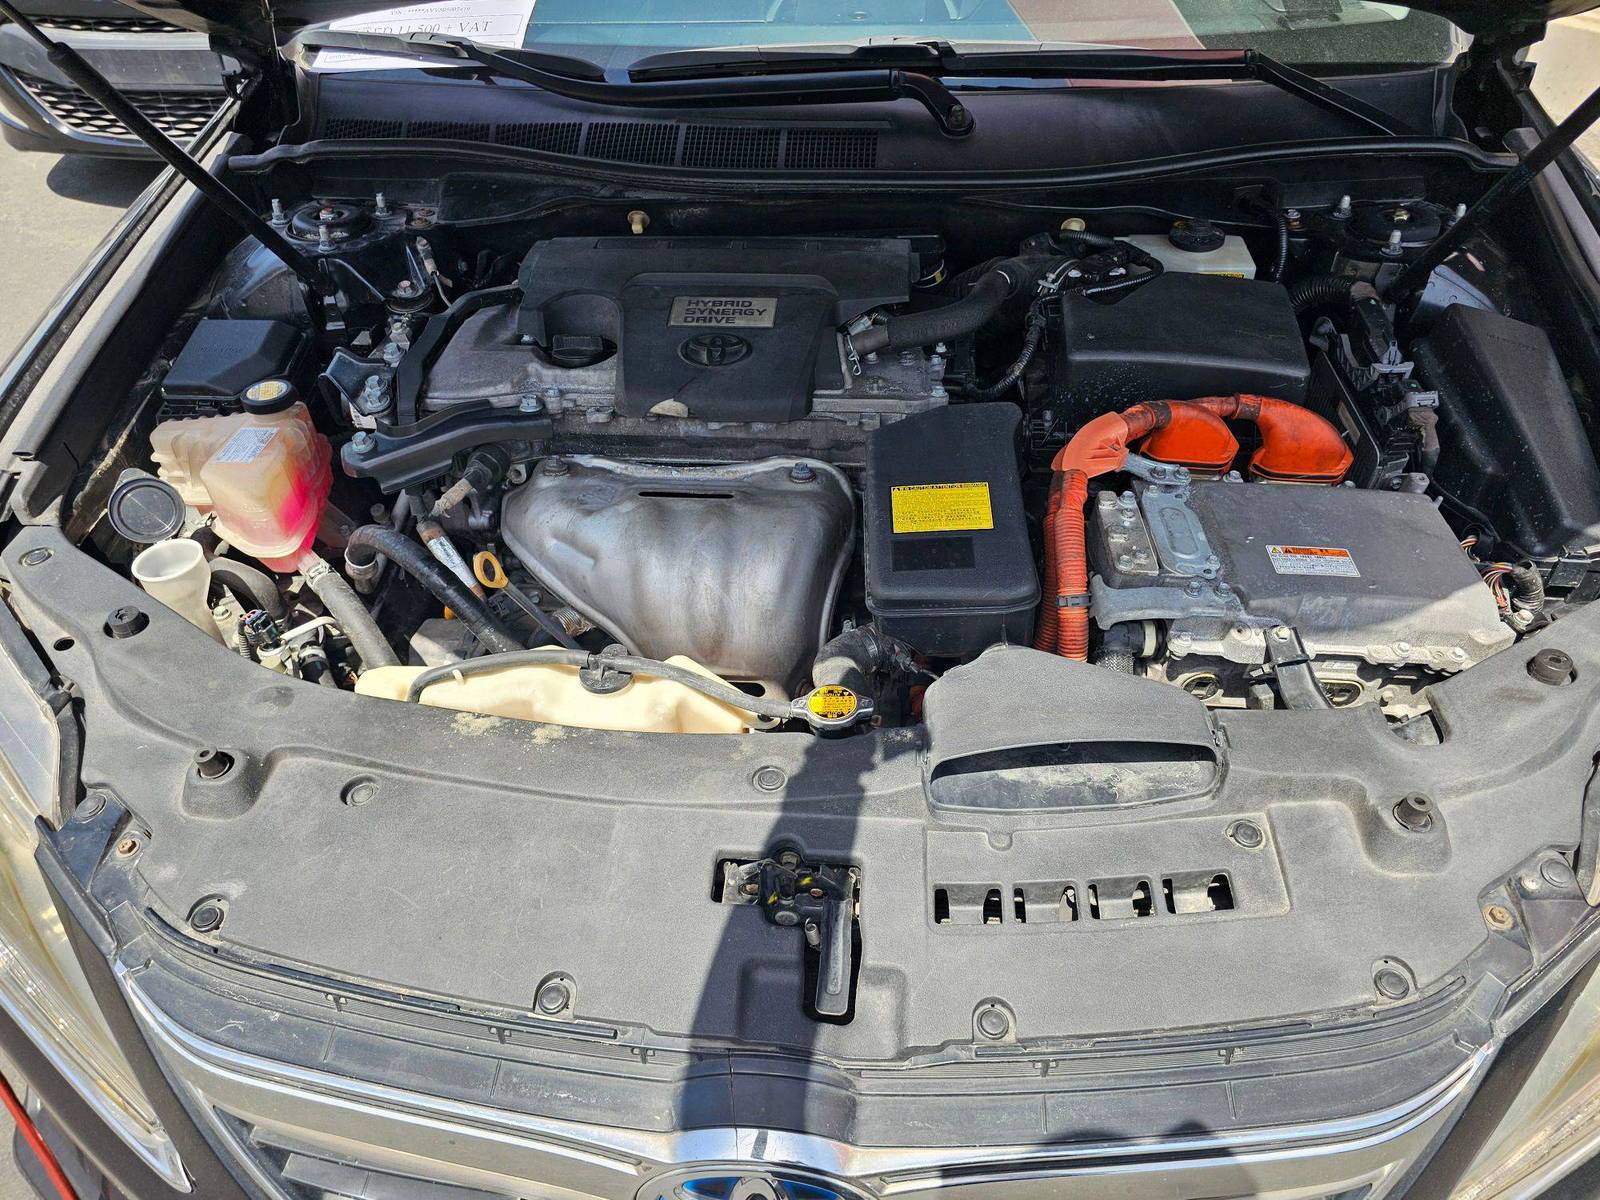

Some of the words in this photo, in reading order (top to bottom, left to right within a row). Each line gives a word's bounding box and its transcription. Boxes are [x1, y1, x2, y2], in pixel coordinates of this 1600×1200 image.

[460, 21, 492, 33] VAT
[687, 300, 753, 308] HYBRID
[685, 308, 768, 316] SYNERGY
[684, 316, 737, 324] DRIVE
